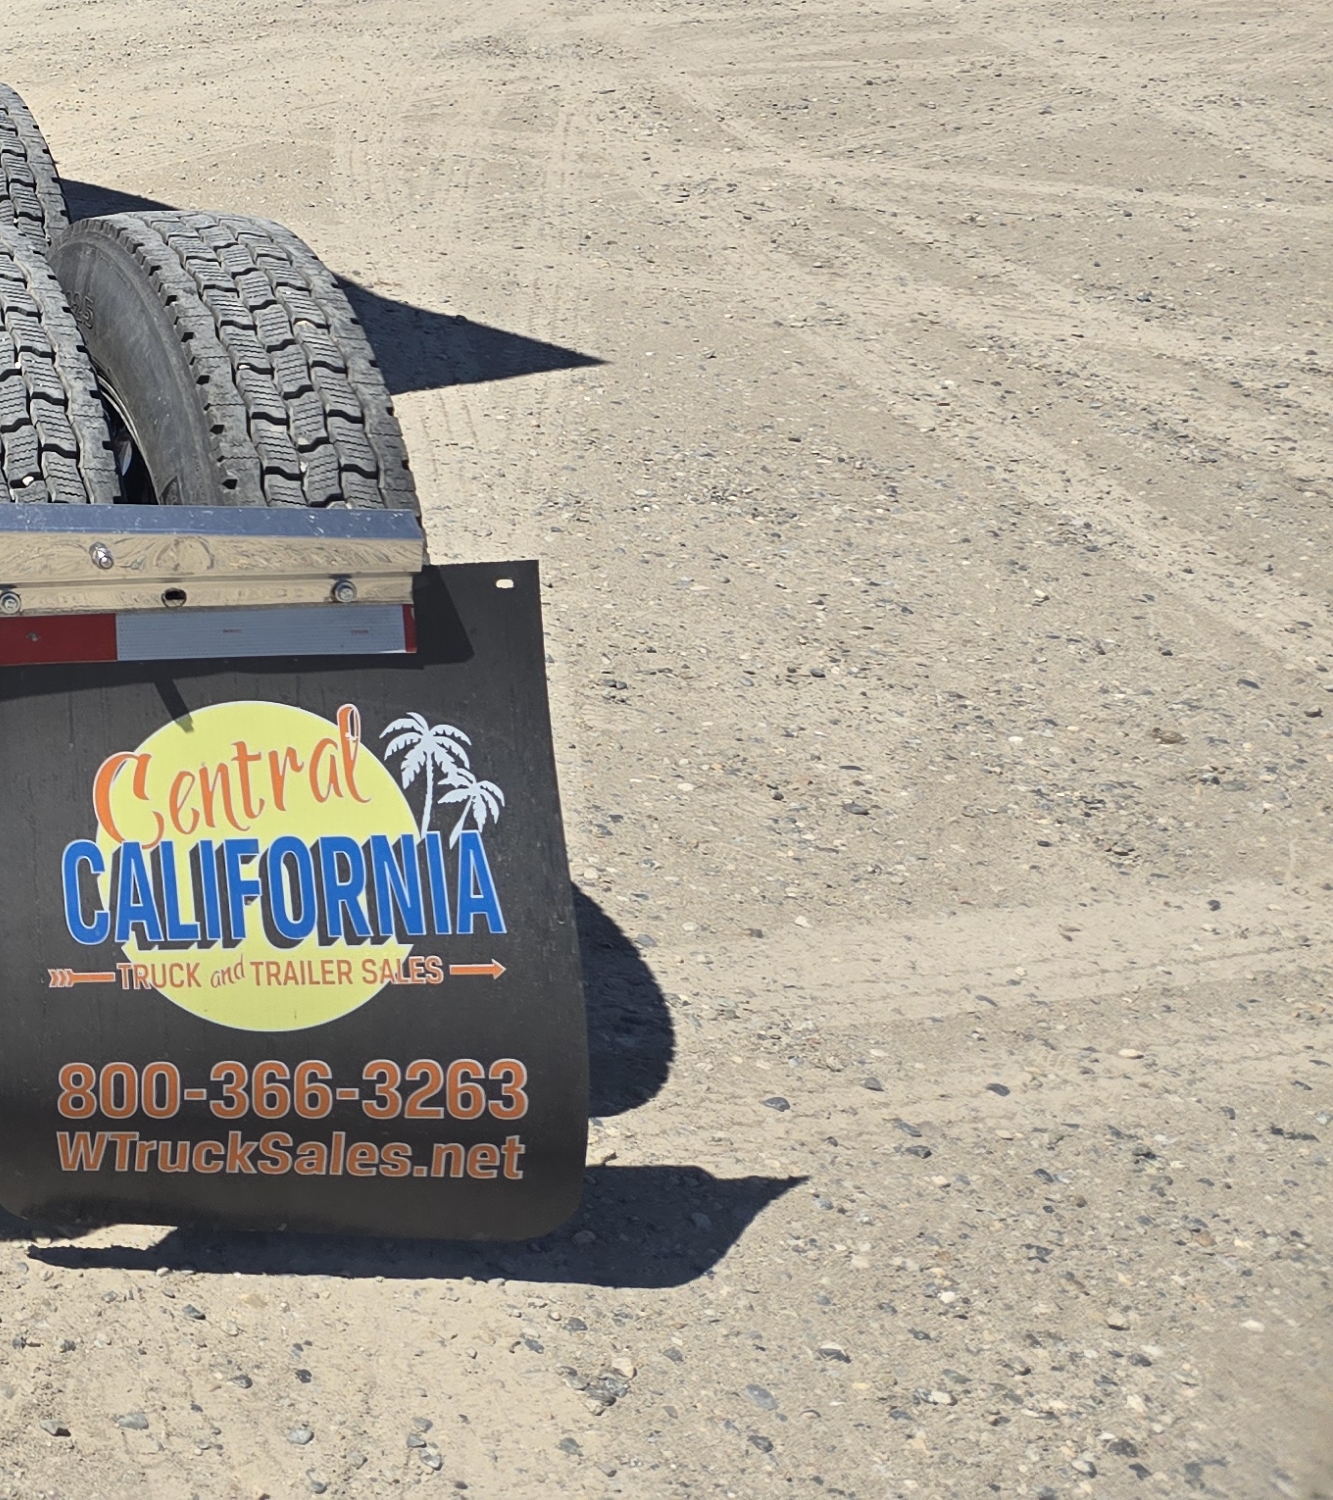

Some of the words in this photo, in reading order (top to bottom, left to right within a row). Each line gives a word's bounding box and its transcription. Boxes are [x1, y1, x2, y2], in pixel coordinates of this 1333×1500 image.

[93, 704, 371, 850] Central
[63, 831, 507, 949] CALIFORNIA
[117, 961, 202, 990] TRUCK
[210, 953, 246, 988] and
[251, 957, 354, 986] TRAILER
[360, 954, 445, 985] SALES
[57, 1059, 529, 1122] 800-366-3263
[57, 1129, 526, 1181] WTruckSales.net
